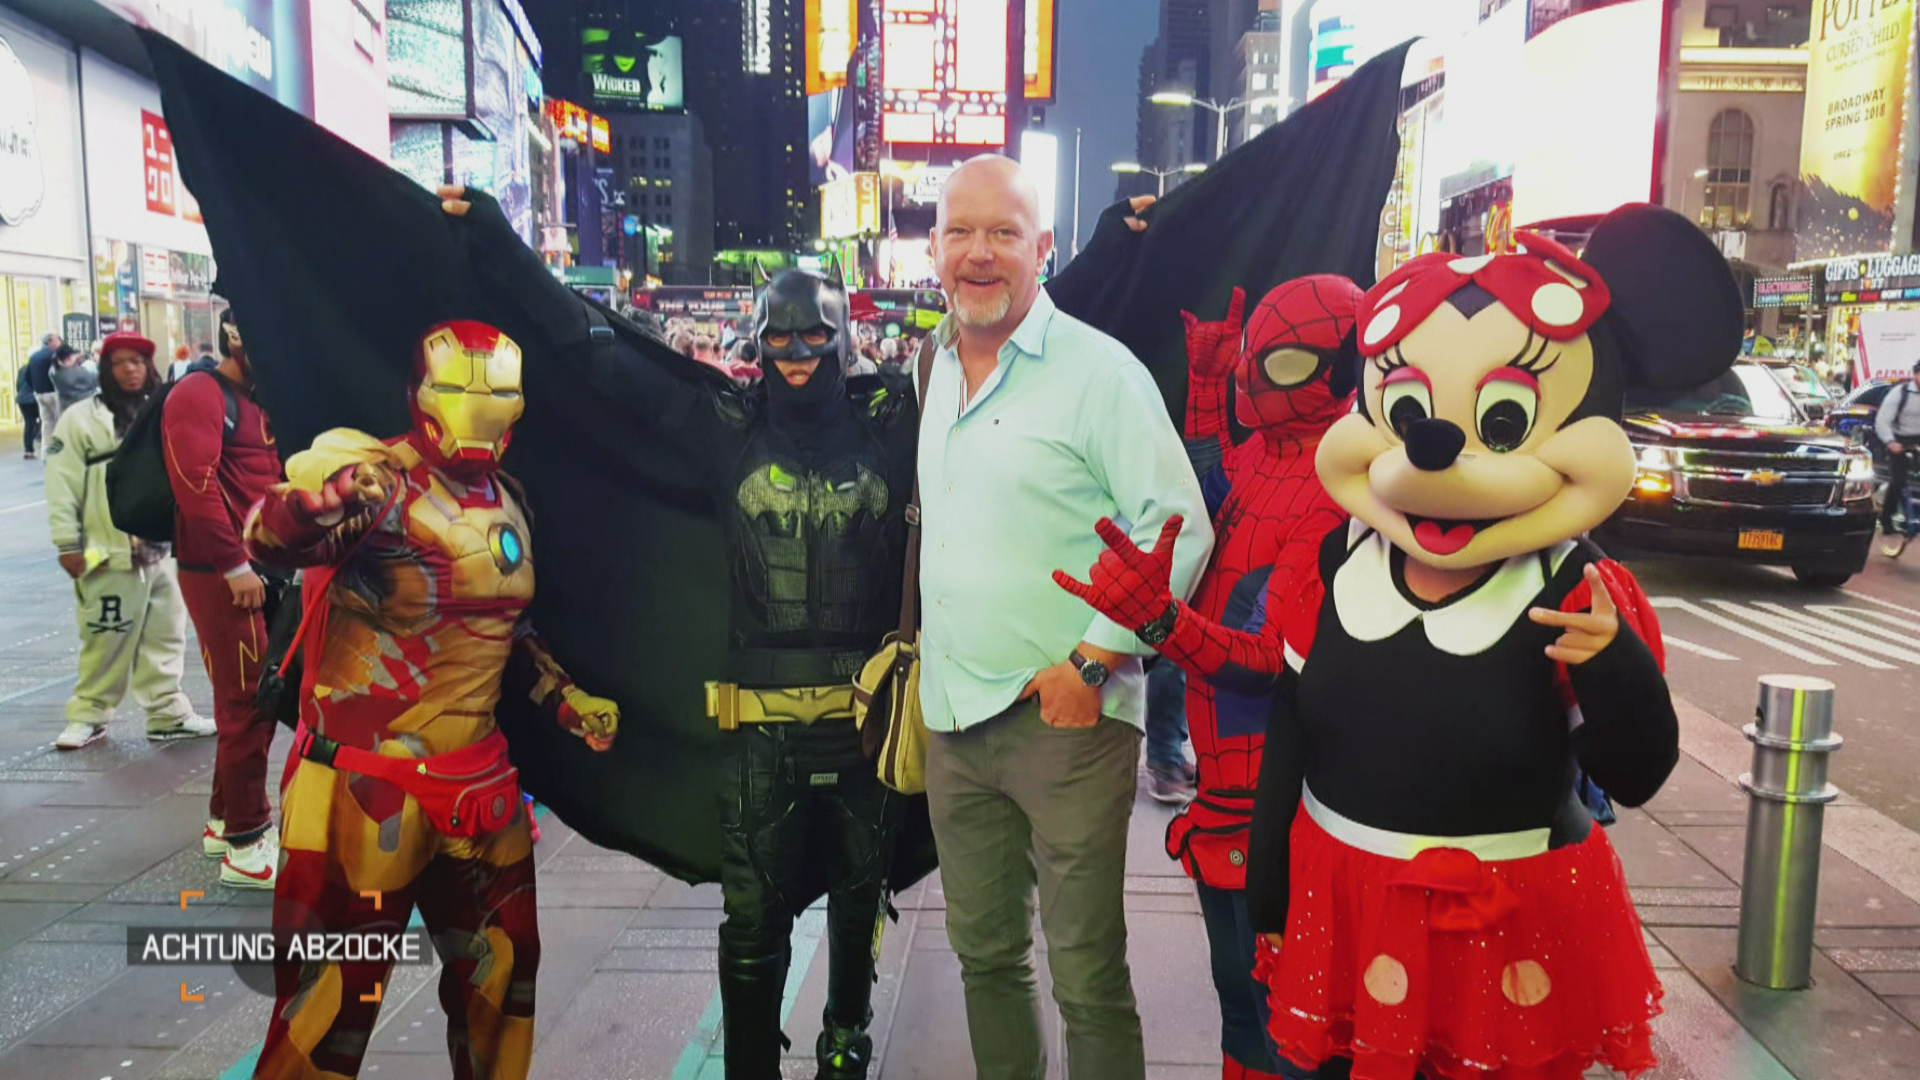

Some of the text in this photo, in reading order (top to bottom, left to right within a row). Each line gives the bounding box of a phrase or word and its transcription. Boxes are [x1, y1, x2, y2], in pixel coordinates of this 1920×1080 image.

[1828, 86, 1886, 115] BROADWAY
[1825, 103, 1886, 131] SPRING 2018
[1825, 260, 1859, 282] GIFTS
[99, 595, 122, 622] R
